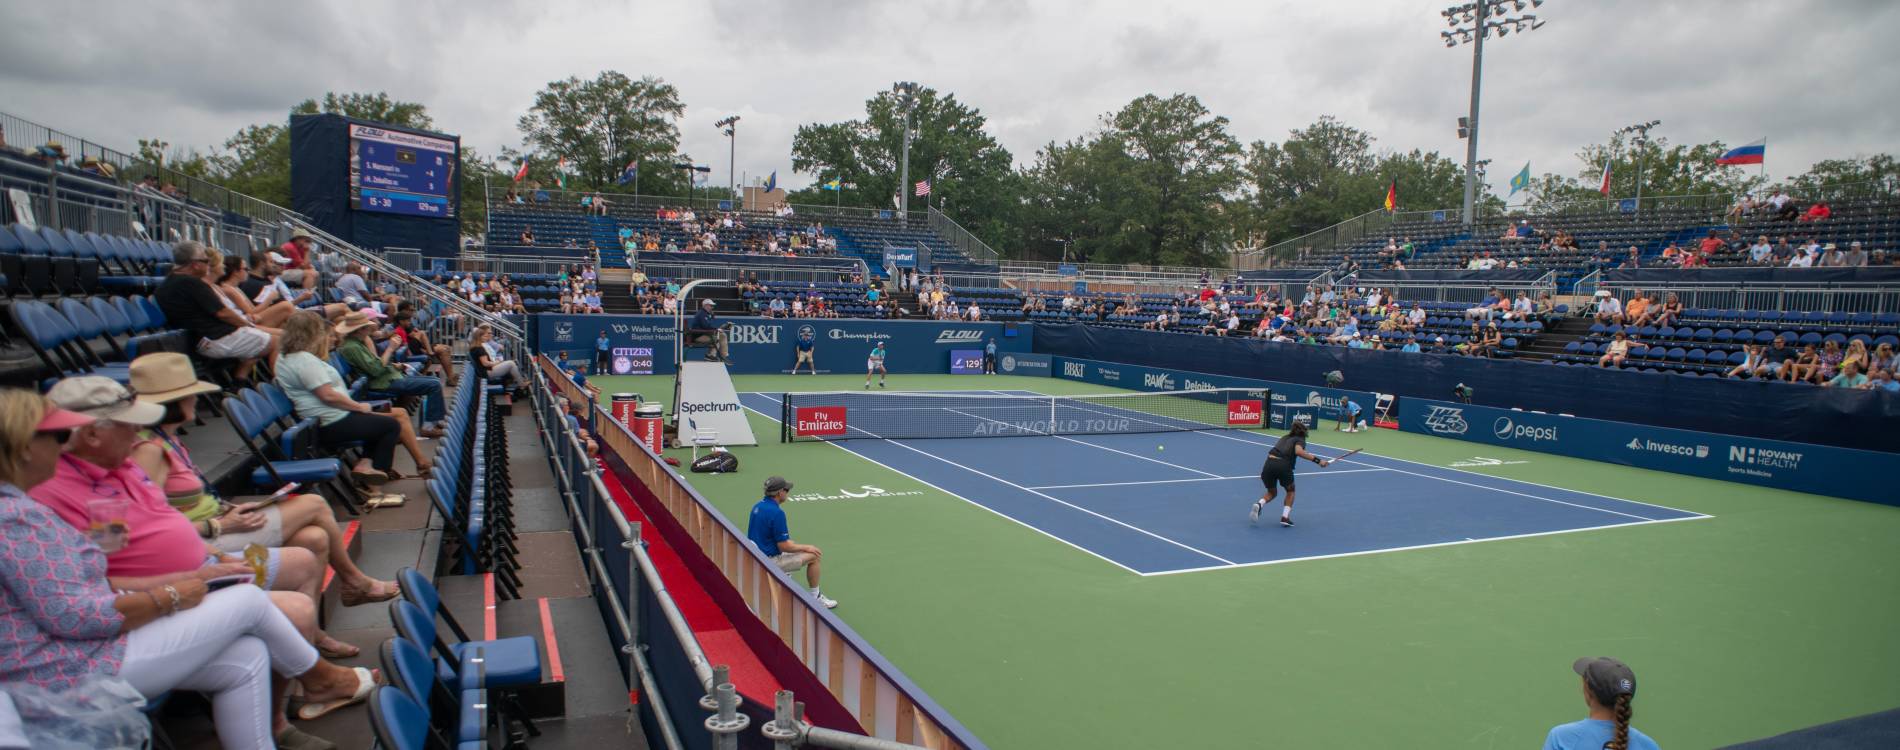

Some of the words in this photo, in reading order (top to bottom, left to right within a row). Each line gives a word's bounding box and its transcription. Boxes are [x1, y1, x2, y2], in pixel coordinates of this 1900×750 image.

[631, 325, 651, 333] Wake
[652, 325, 675, 333] Forest
[729, 325, 783, 344] BB&T
[937, 330, 984, 340] FLOW
[631, 333, 653, 341] Baptist
[655, 333, 676, 341] Health
[828, 329, 892, 342] Champion
[612, 347, 652, 356] CITIZEN
[965, 359, 979, 368] 129
[1064, 362, 1085, 378] BB&T
[681, 401, 737, 414] Spectrum
[1240, 404, 1250, 412] Fly
[814, 411, 828, 420] Fly
[1229, 411, 1260, 421] Emirates
[799, 420, 844, 431] Emirates
[973, 421, 1011, 434] ATP
[1014, 420, 1079, 434] WORLD
[1085, 419, 1130, 432] TOUR
[1515, 424, 1557, 441] pepsi
[1646, 439, 1694, 456] Invesco
[1758, 449, 1803, 462] NOVANT
[1757, 457, 1798, 470] HEALTH
[1727, 466, 1746, 474] Sports
[1746, 469, 1772, 478] Medicine
